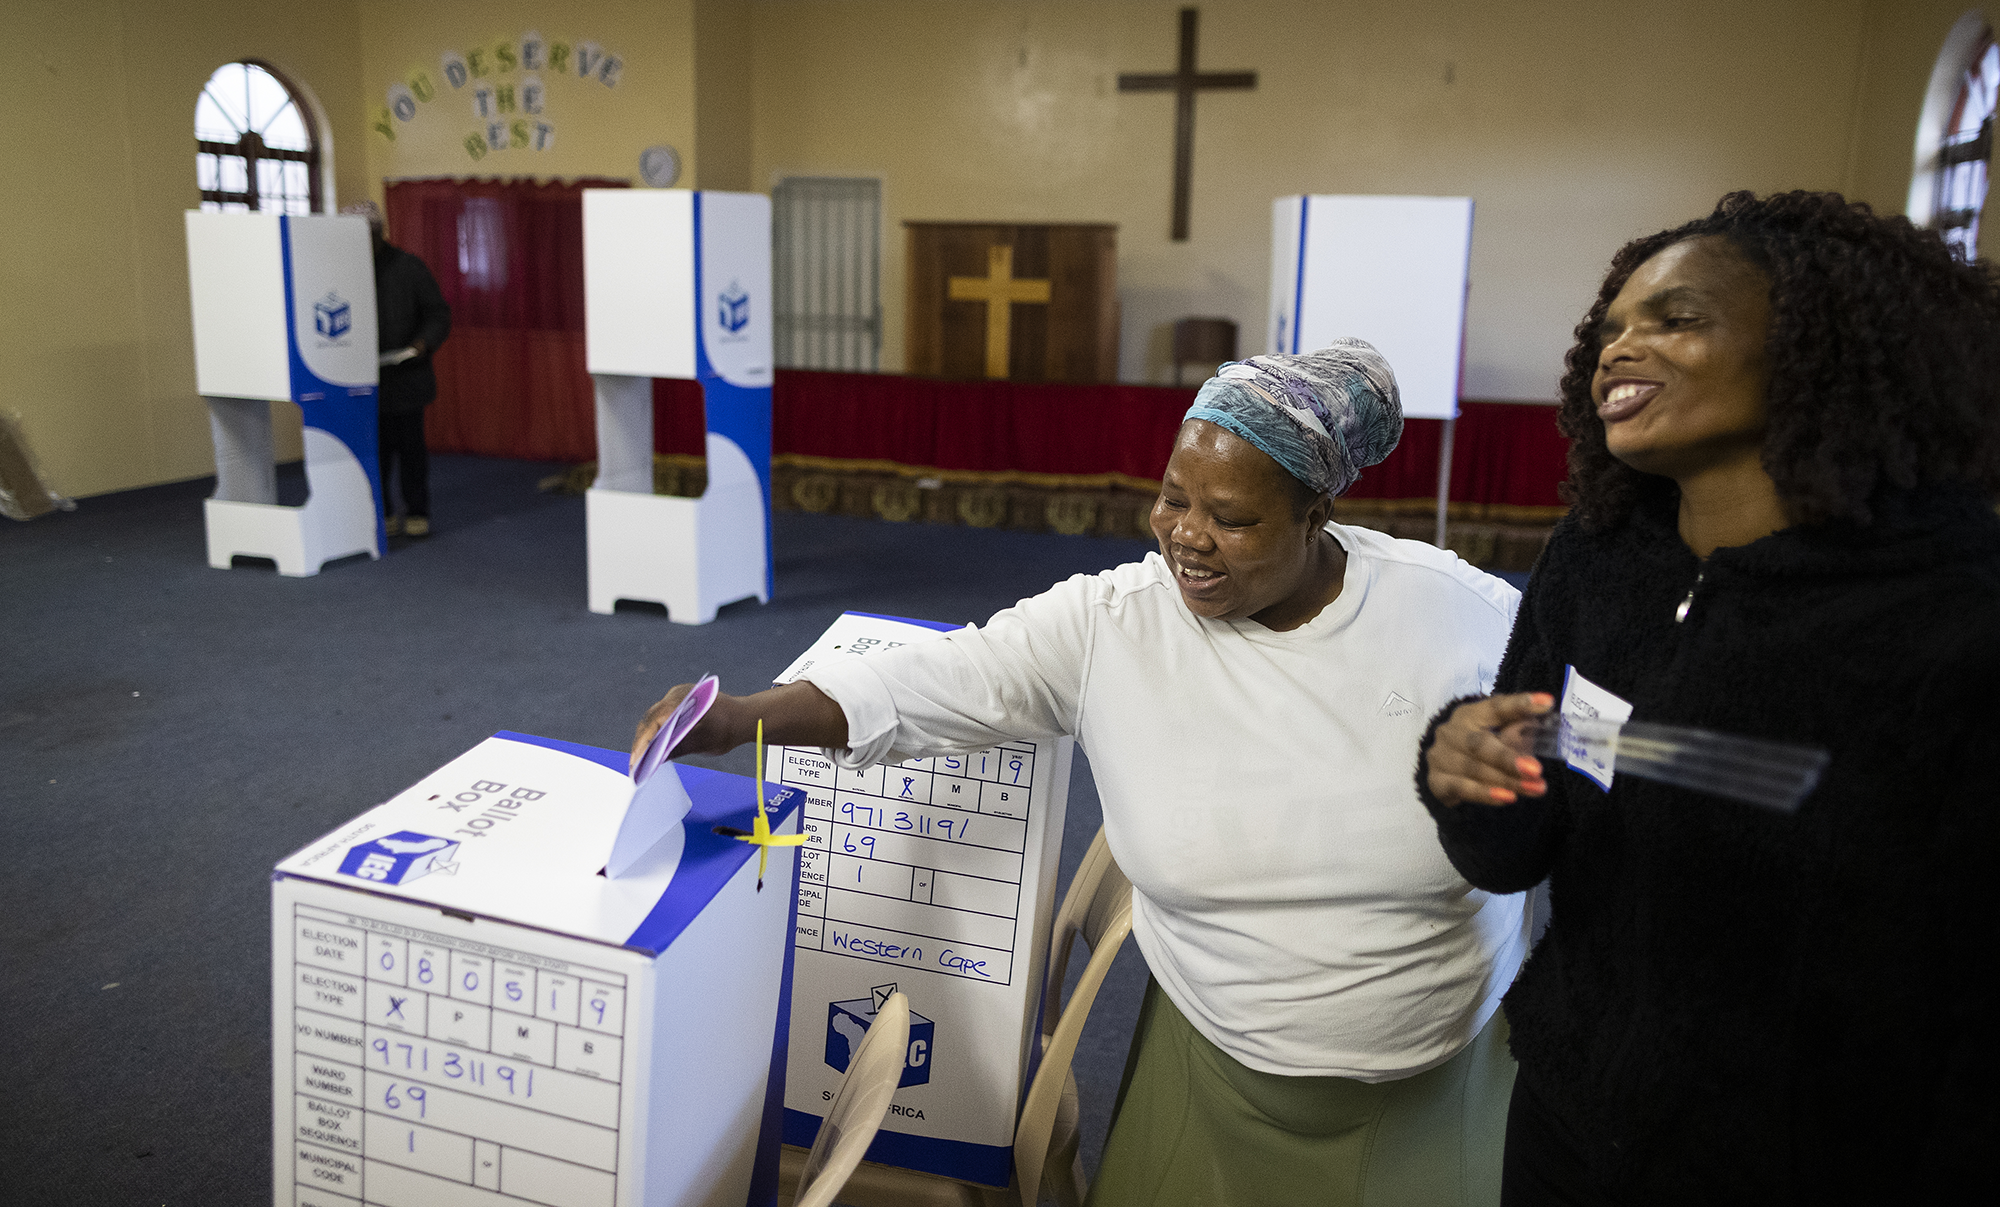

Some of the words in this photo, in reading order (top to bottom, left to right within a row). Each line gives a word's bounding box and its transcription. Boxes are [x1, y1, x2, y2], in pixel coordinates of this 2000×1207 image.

[374, 73, 434, 141] YOU
[444, 38, 623, 89] DESERVE
[475, 83, 544, 118] THE
[463, 118, 552, 161] BEST
[788, 756, 832, 770] ELECTION
[798, 768, 821, 779] TYPE
[1009, 760, 1024, 784] 9
[438, 779, 509, 813] Box
[856, 769, 865, 778] N
[951, 784, 961, 795] M
[1000, 792, 1009, 801] B
[455, 787, 548, 838] Ballot
[804, 824, 818, 833] RD
[801, 851, 820, 860] LOT
[844, 833, 876, 859] 69
[356, 852, 398, 881] IEC
[800, 860, 811, 869] OX
[857, 865, 863, 882] 1
[801, 871, 825, 881] ENCE
[798, 888, 822, 899] CIPAL
[799, 899, 811, 907] DE
[302, 928, 359, 949] ELECTION
[315, 945, 345, 960] DATE
[833, 931, 922, 961] Western
[939, 949, 991, 977] Cape
[302, 973, 358, 995] ELECTION
[381, 951, 395, 971] 0
[418, 957, 434, 984] 8
[463, 970, 479, 992] 0
[505, 981, 523, 1002] 5
[551, 988, 557, 1010] 1
[590, 998, 606, 1026] 9
[316, 990, 344, 1006] TYPE
[297, 1024, 312, 1036] VD
[315, 1028, 364, 1048] NUMBER
[454, 1011, 464, 1022] P
[518, 1026, 530, 1040] M
[583, 1041, 594, 1054] B
[312, 1064, 346, 1081] WARD
[305, 1077, 353, 1097] NUMBER
[308, 1100, 351, 1119] BALLOT
[385, 1083, 427, 1118] 69
[318, 1116, 342, 1131] BOX
[300, 1127, 360, 1149] SEQUENCE
[409, 1130, 415, 1152] 1
[300, 1150, 358, 1174] MUNICIPAL
[313, 1168, 345, 1184] CODE
